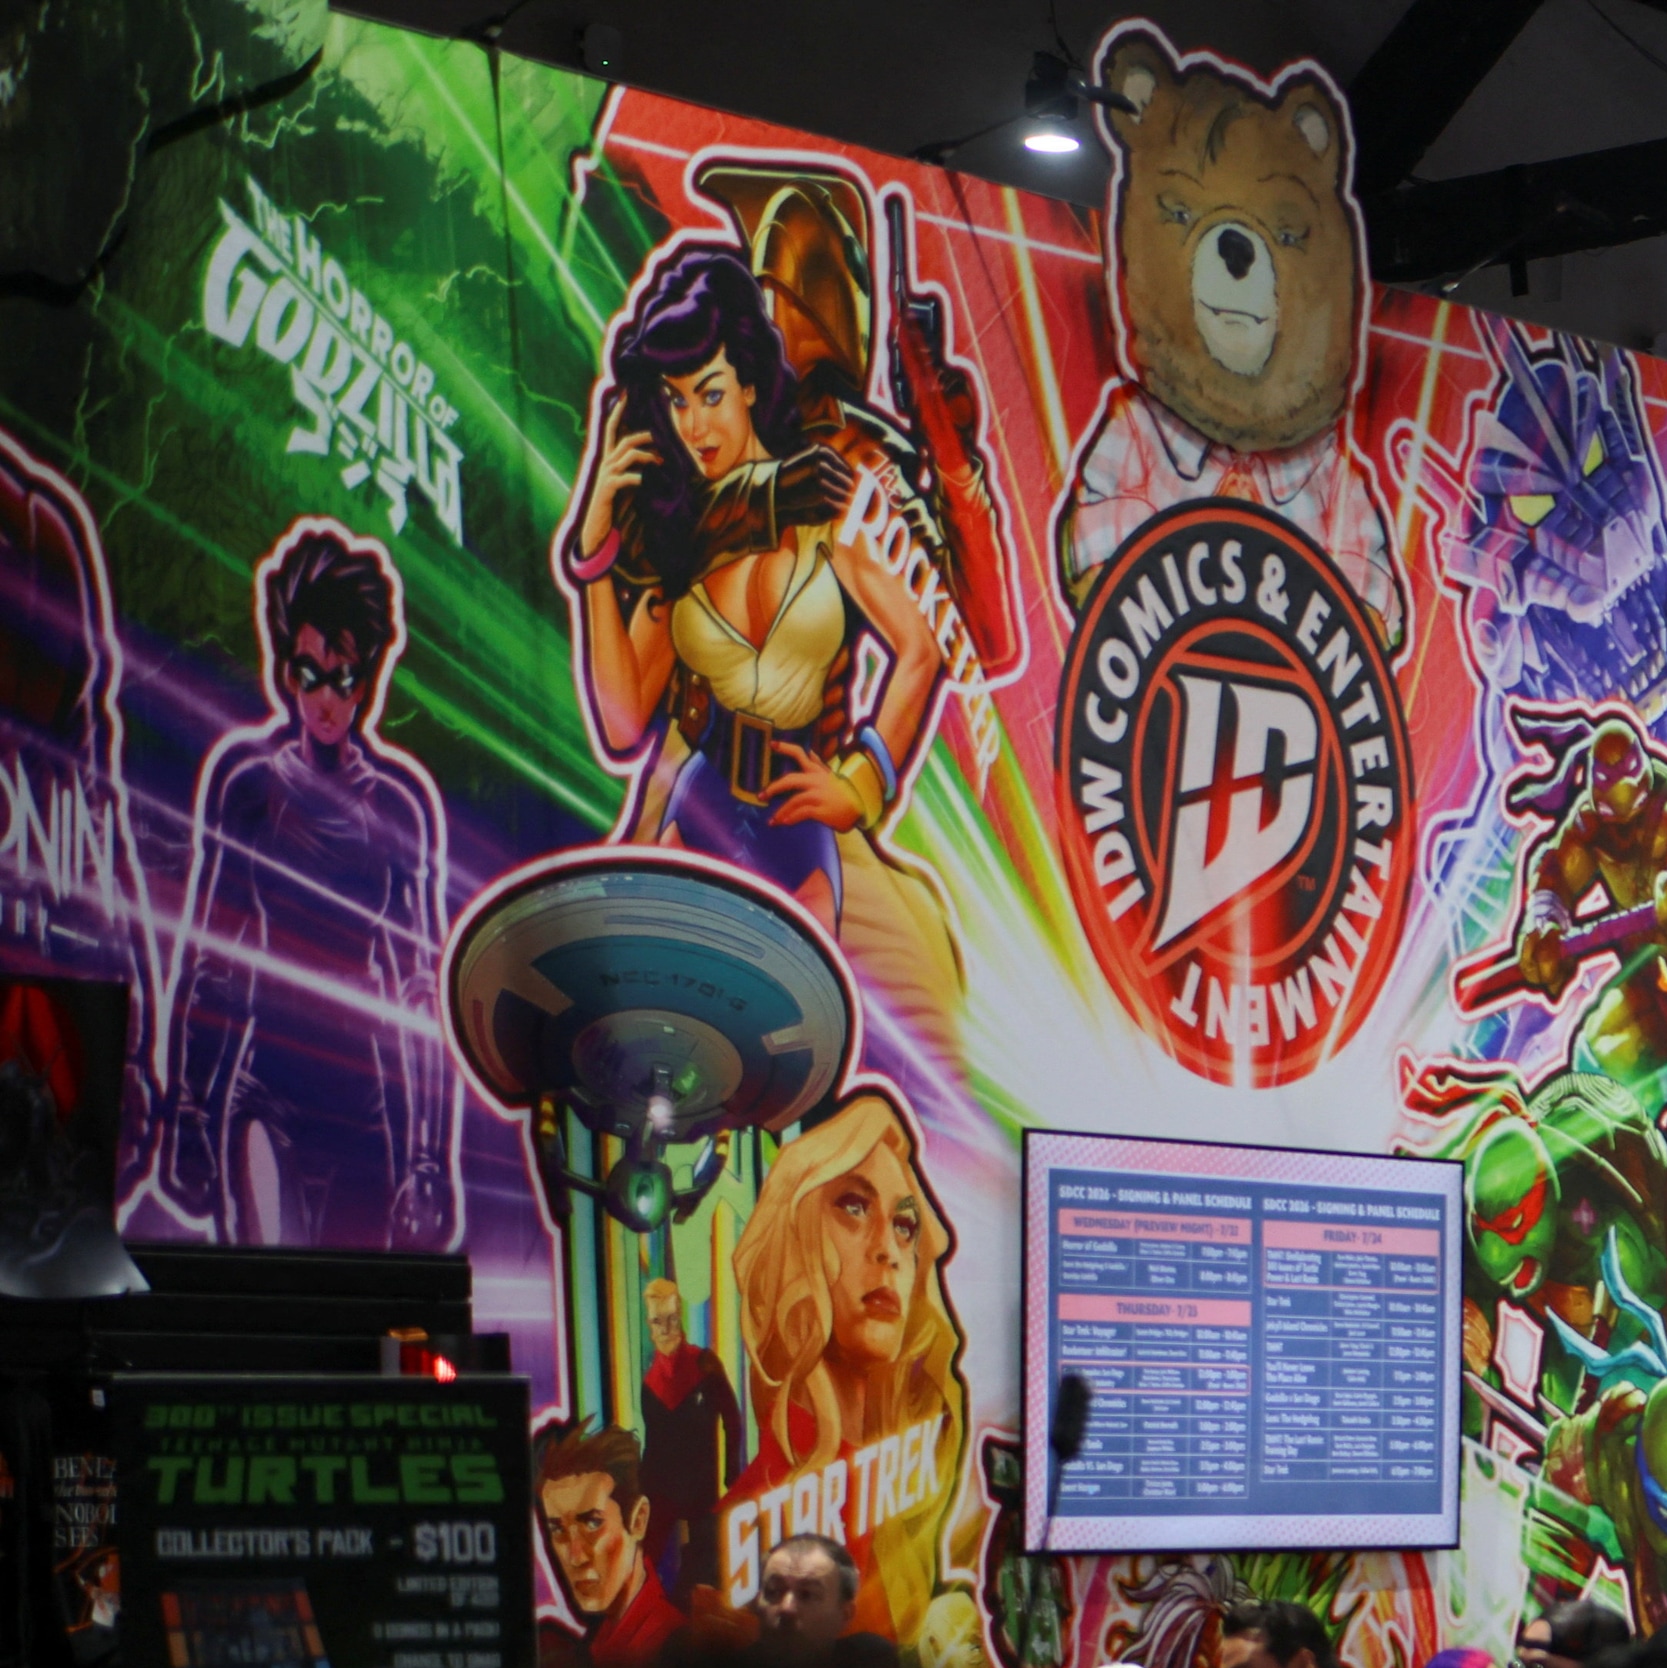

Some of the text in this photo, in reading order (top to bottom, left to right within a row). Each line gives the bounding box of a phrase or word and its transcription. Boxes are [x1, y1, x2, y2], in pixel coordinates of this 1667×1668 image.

[203, 197, 465, 549] GODZILLA
[247, 174, 460, 430] THE HORROR OF
[1082, 539, 1395, 1048] IDW COMICS & ENTERTAINMENT
[148, 1453, 505, 1505] TURTLES
[242, 1403, 498, 1428] ISSUE SPECIAL
[727, 1412, 945, 1610] STAR TREK
[156, 1527, 311, 1558] COLLECTOR'S
[318, 1528, 374, 1557] PACK
[414, 1521, 496, 1564] $100
